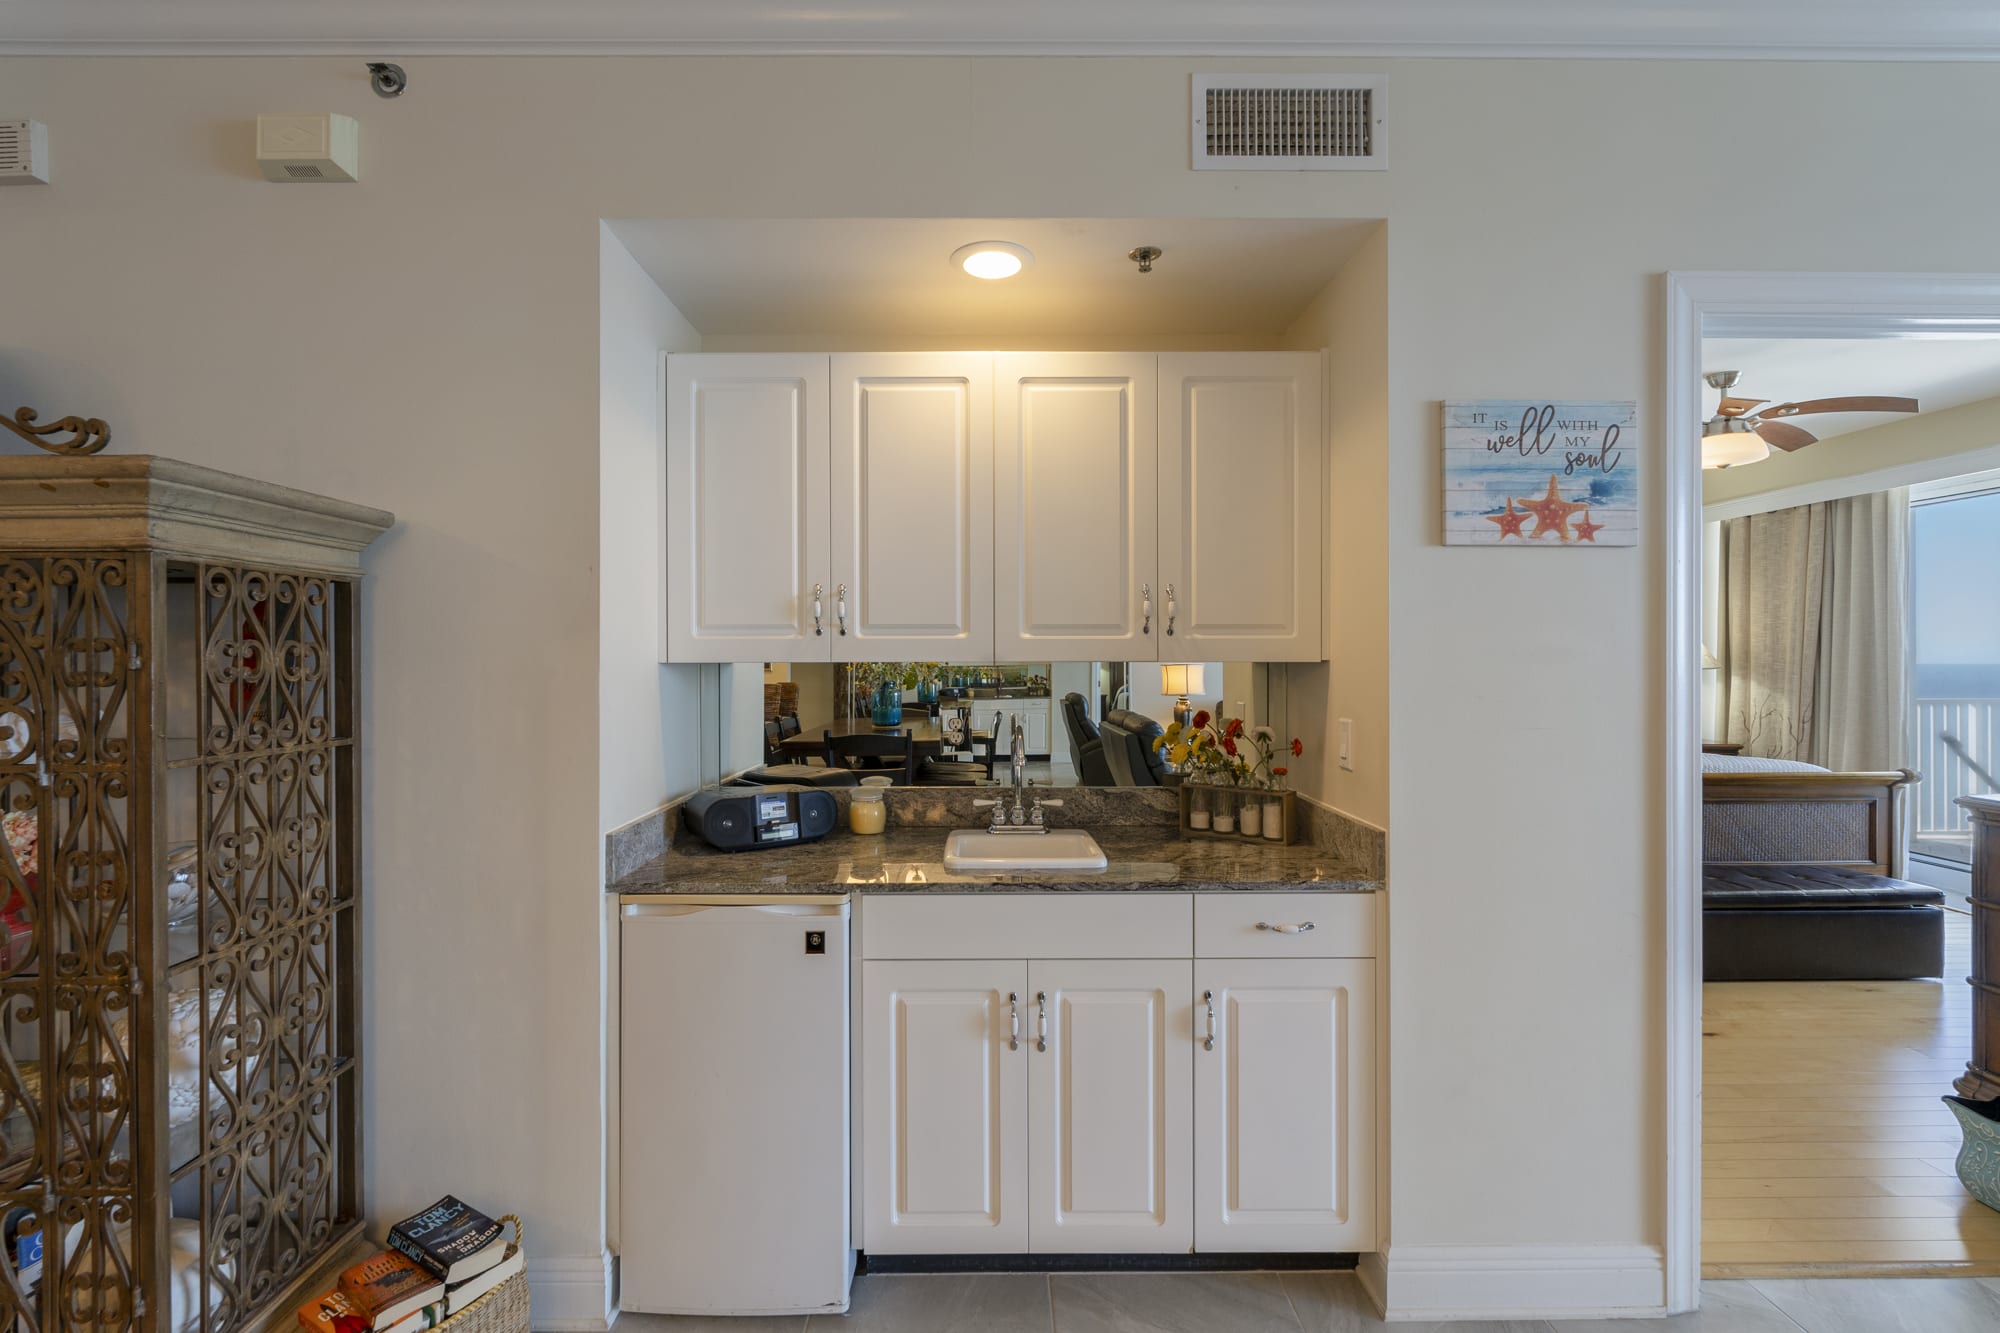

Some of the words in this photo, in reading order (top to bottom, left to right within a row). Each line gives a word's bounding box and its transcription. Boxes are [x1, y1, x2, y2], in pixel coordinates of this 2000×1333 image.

[1473, 413, 1487, 424] IT
[1494, 420, 1508, 431] IS
[1557, 420, 1598, 431] WITH
[1487, 404, 1556, 456] well
[1564, 424, 1621, 476] soul
[1565, 436, 1591, 447] MY
[408, 1202, 465, 1238] CLANCY
[414, 1206, 446, 1226] TOM
[436, 1229, 477, 1254] SHADOW
[460, 1225, 499, 1253] DRAGON
[324, 1292, 345, 1305] TO
